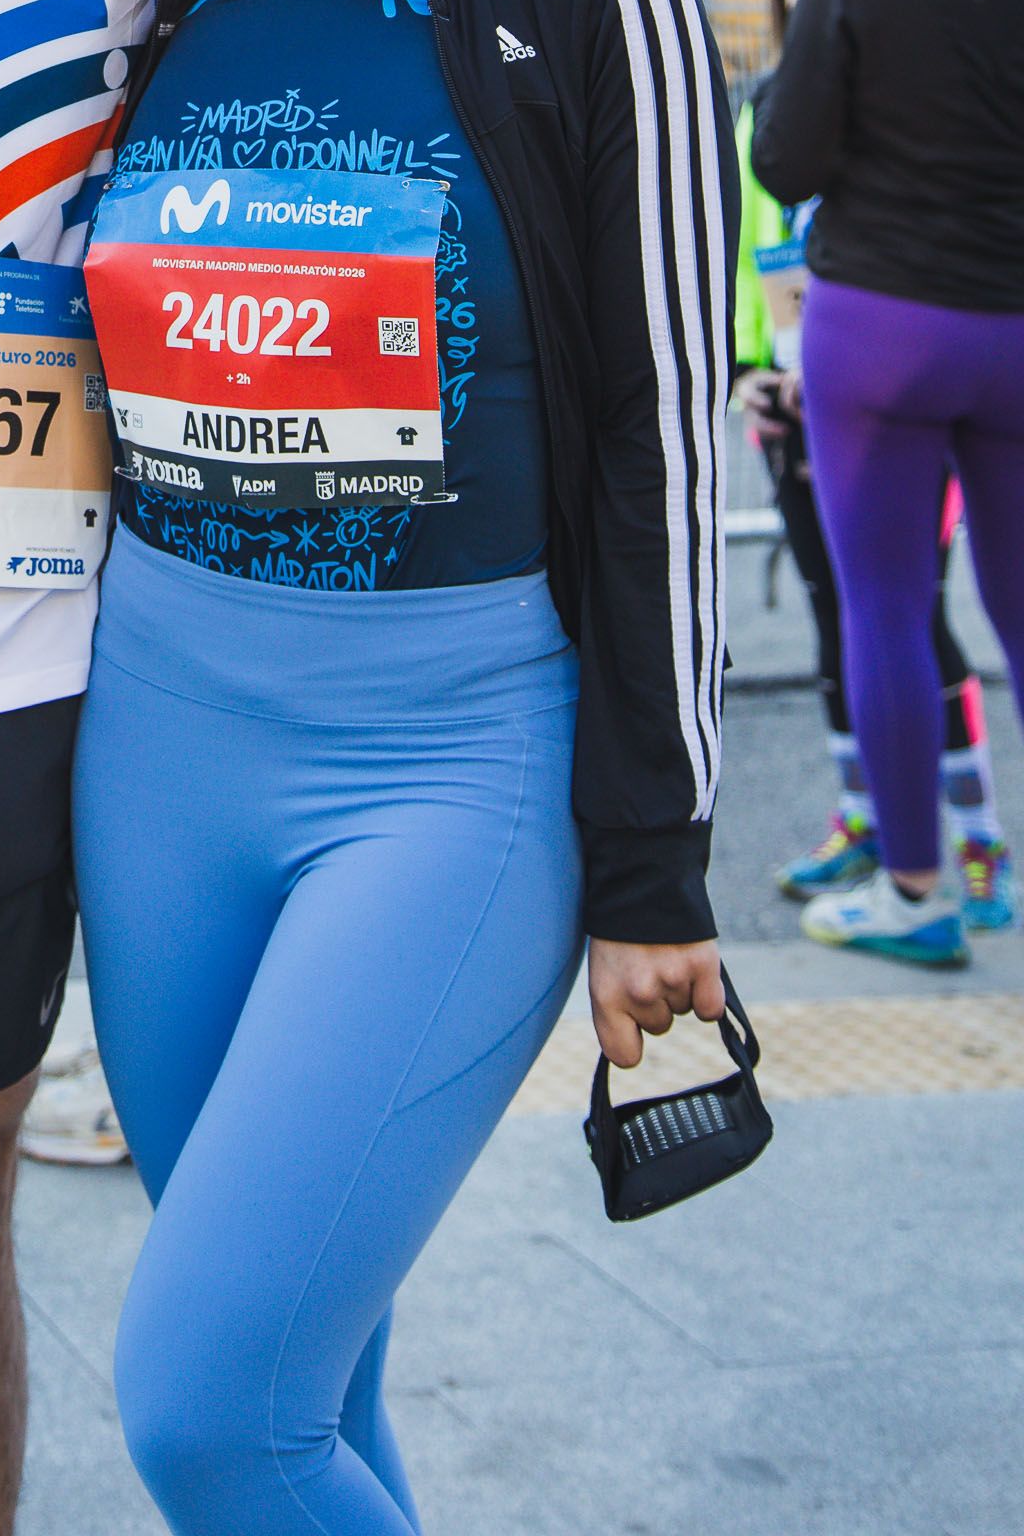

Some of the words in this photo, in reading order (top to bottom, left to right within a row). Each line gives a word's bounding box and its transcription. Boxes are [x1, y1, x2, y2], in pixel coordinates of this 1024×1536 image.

[198, 88, 317, 137] MADRID
[117, 135, 176, 173] GRAN
[246, 196, 373, 228] movistar
[152, 258, 204, 270] MOVISTAR
[205, 260, 246, 272] MADRID
[248, 263, 282, 274] MEDIO
[283, 265, 336, 277] MARATÓN
[337, 268, 366, 278] 2026
[162, 291, 332, 357] 24022
[35, 350, 77, 368] 2026
[183, 410, 330, 455] ANDREA
[241, 479, 276, 493] ADM
[340, 475, 424, 496] MADRID
